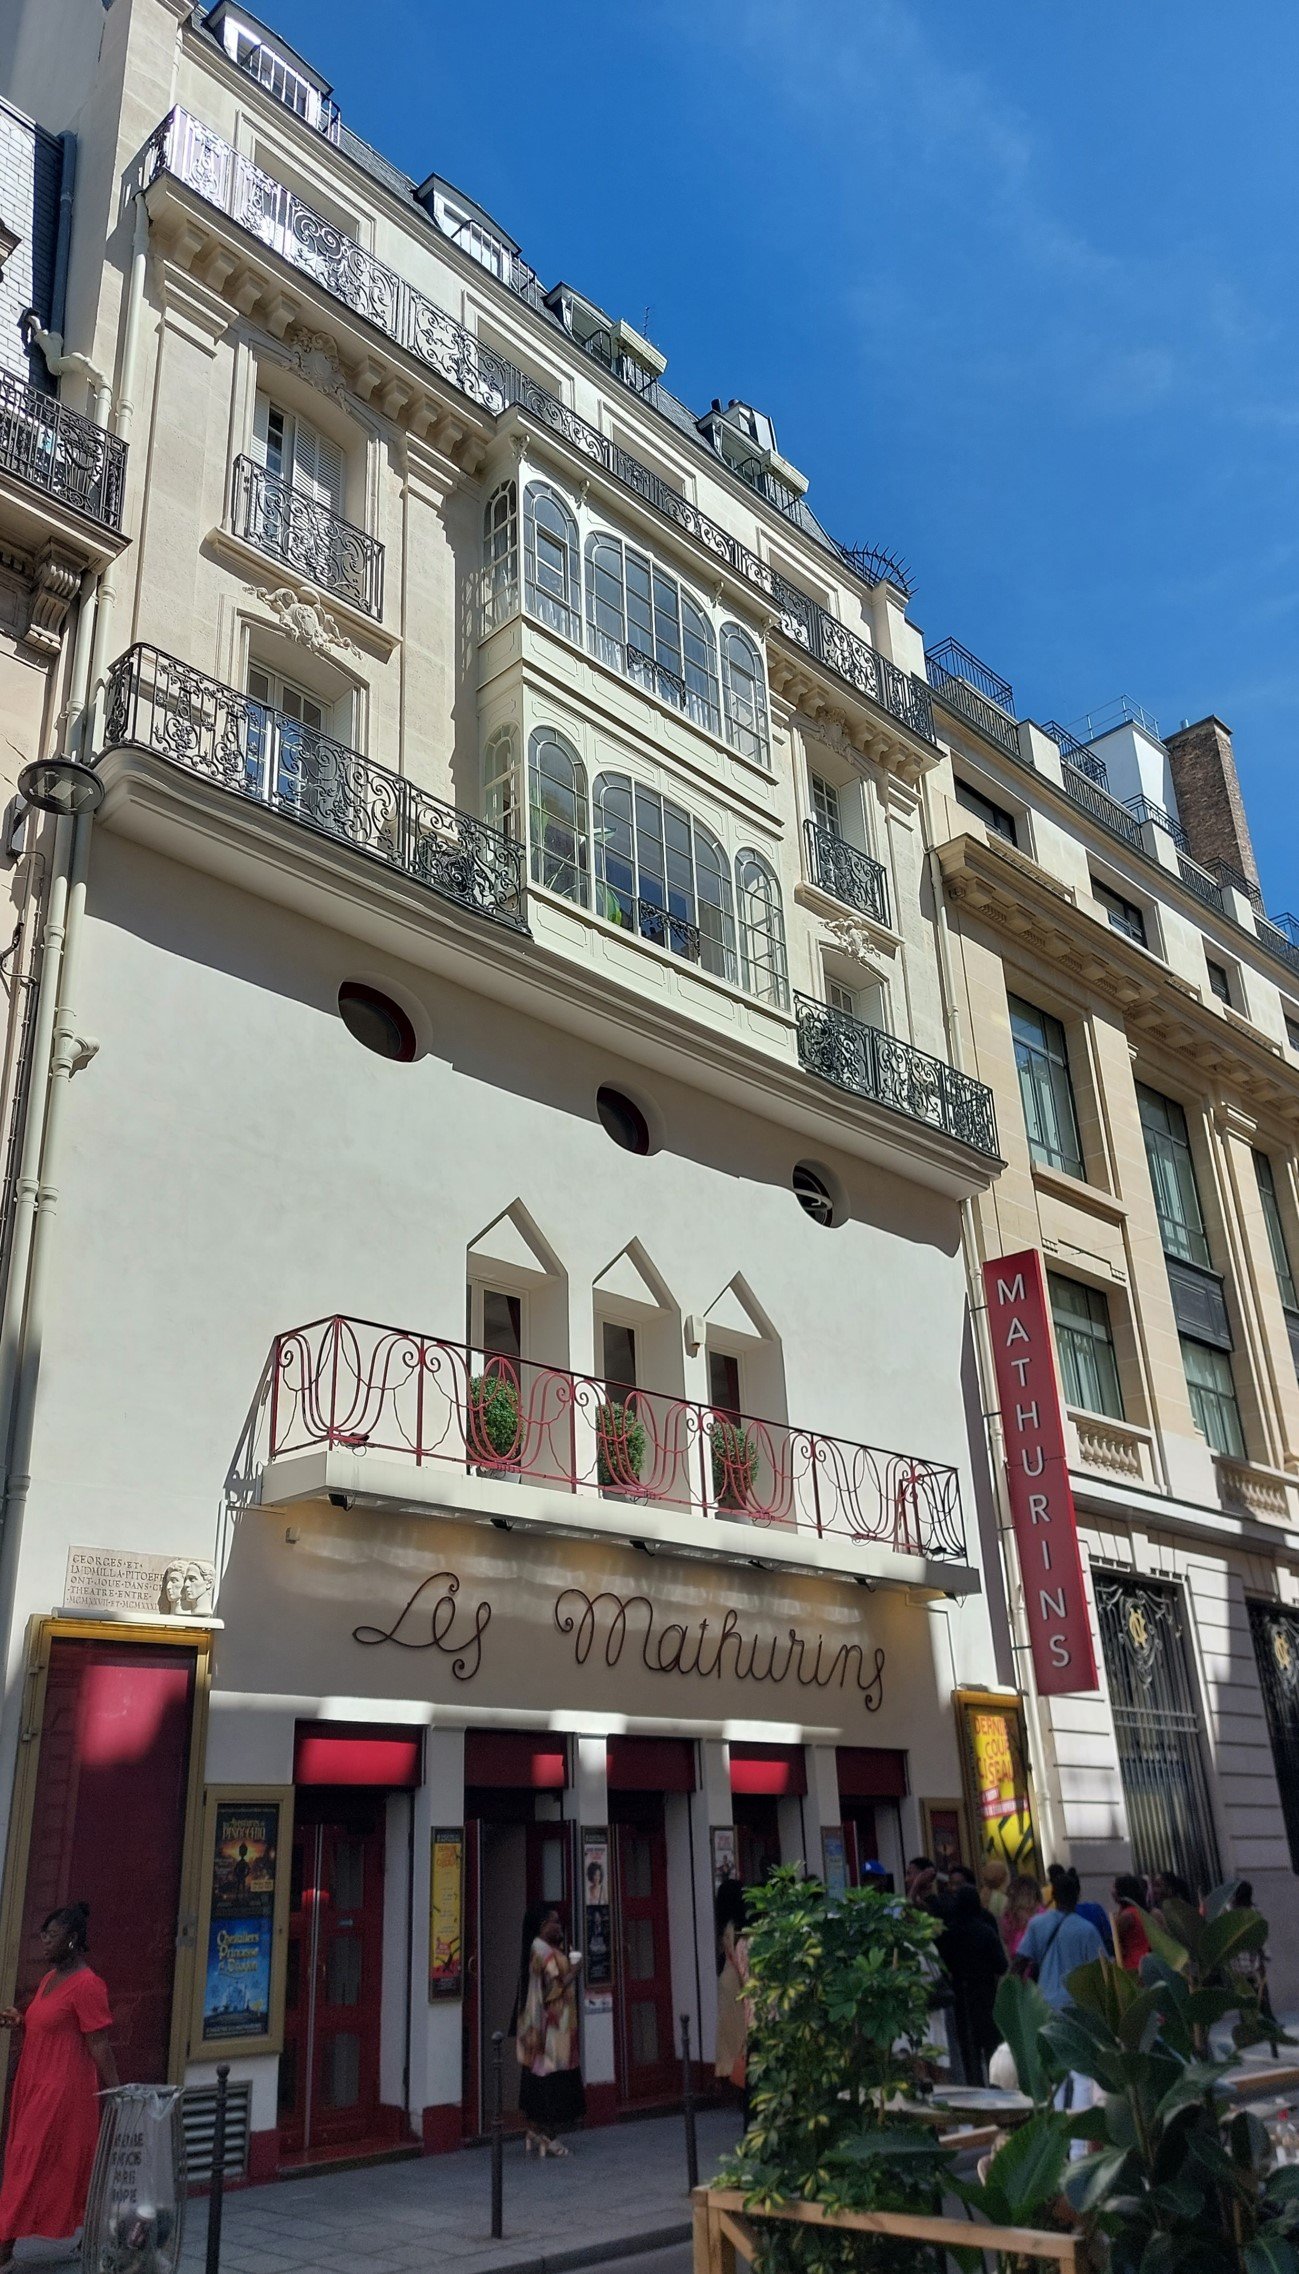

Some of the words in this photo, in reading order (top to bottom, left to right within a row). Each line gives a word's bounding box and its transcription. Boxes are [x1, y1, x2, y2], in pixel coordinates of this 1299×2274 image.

[997, 1274, 1071, 1668] MATHURINS
[70, 1576, 91, 1585] ONT
[125, 1582, 149, 1590] DANS
[71, 1586, 115, 1597] THEATRE
[118, 1590, 149, 1600] ENTRE
[352, 1572, 492, 1680] Les
[555, 1589, 885, 1712] Mathurins
